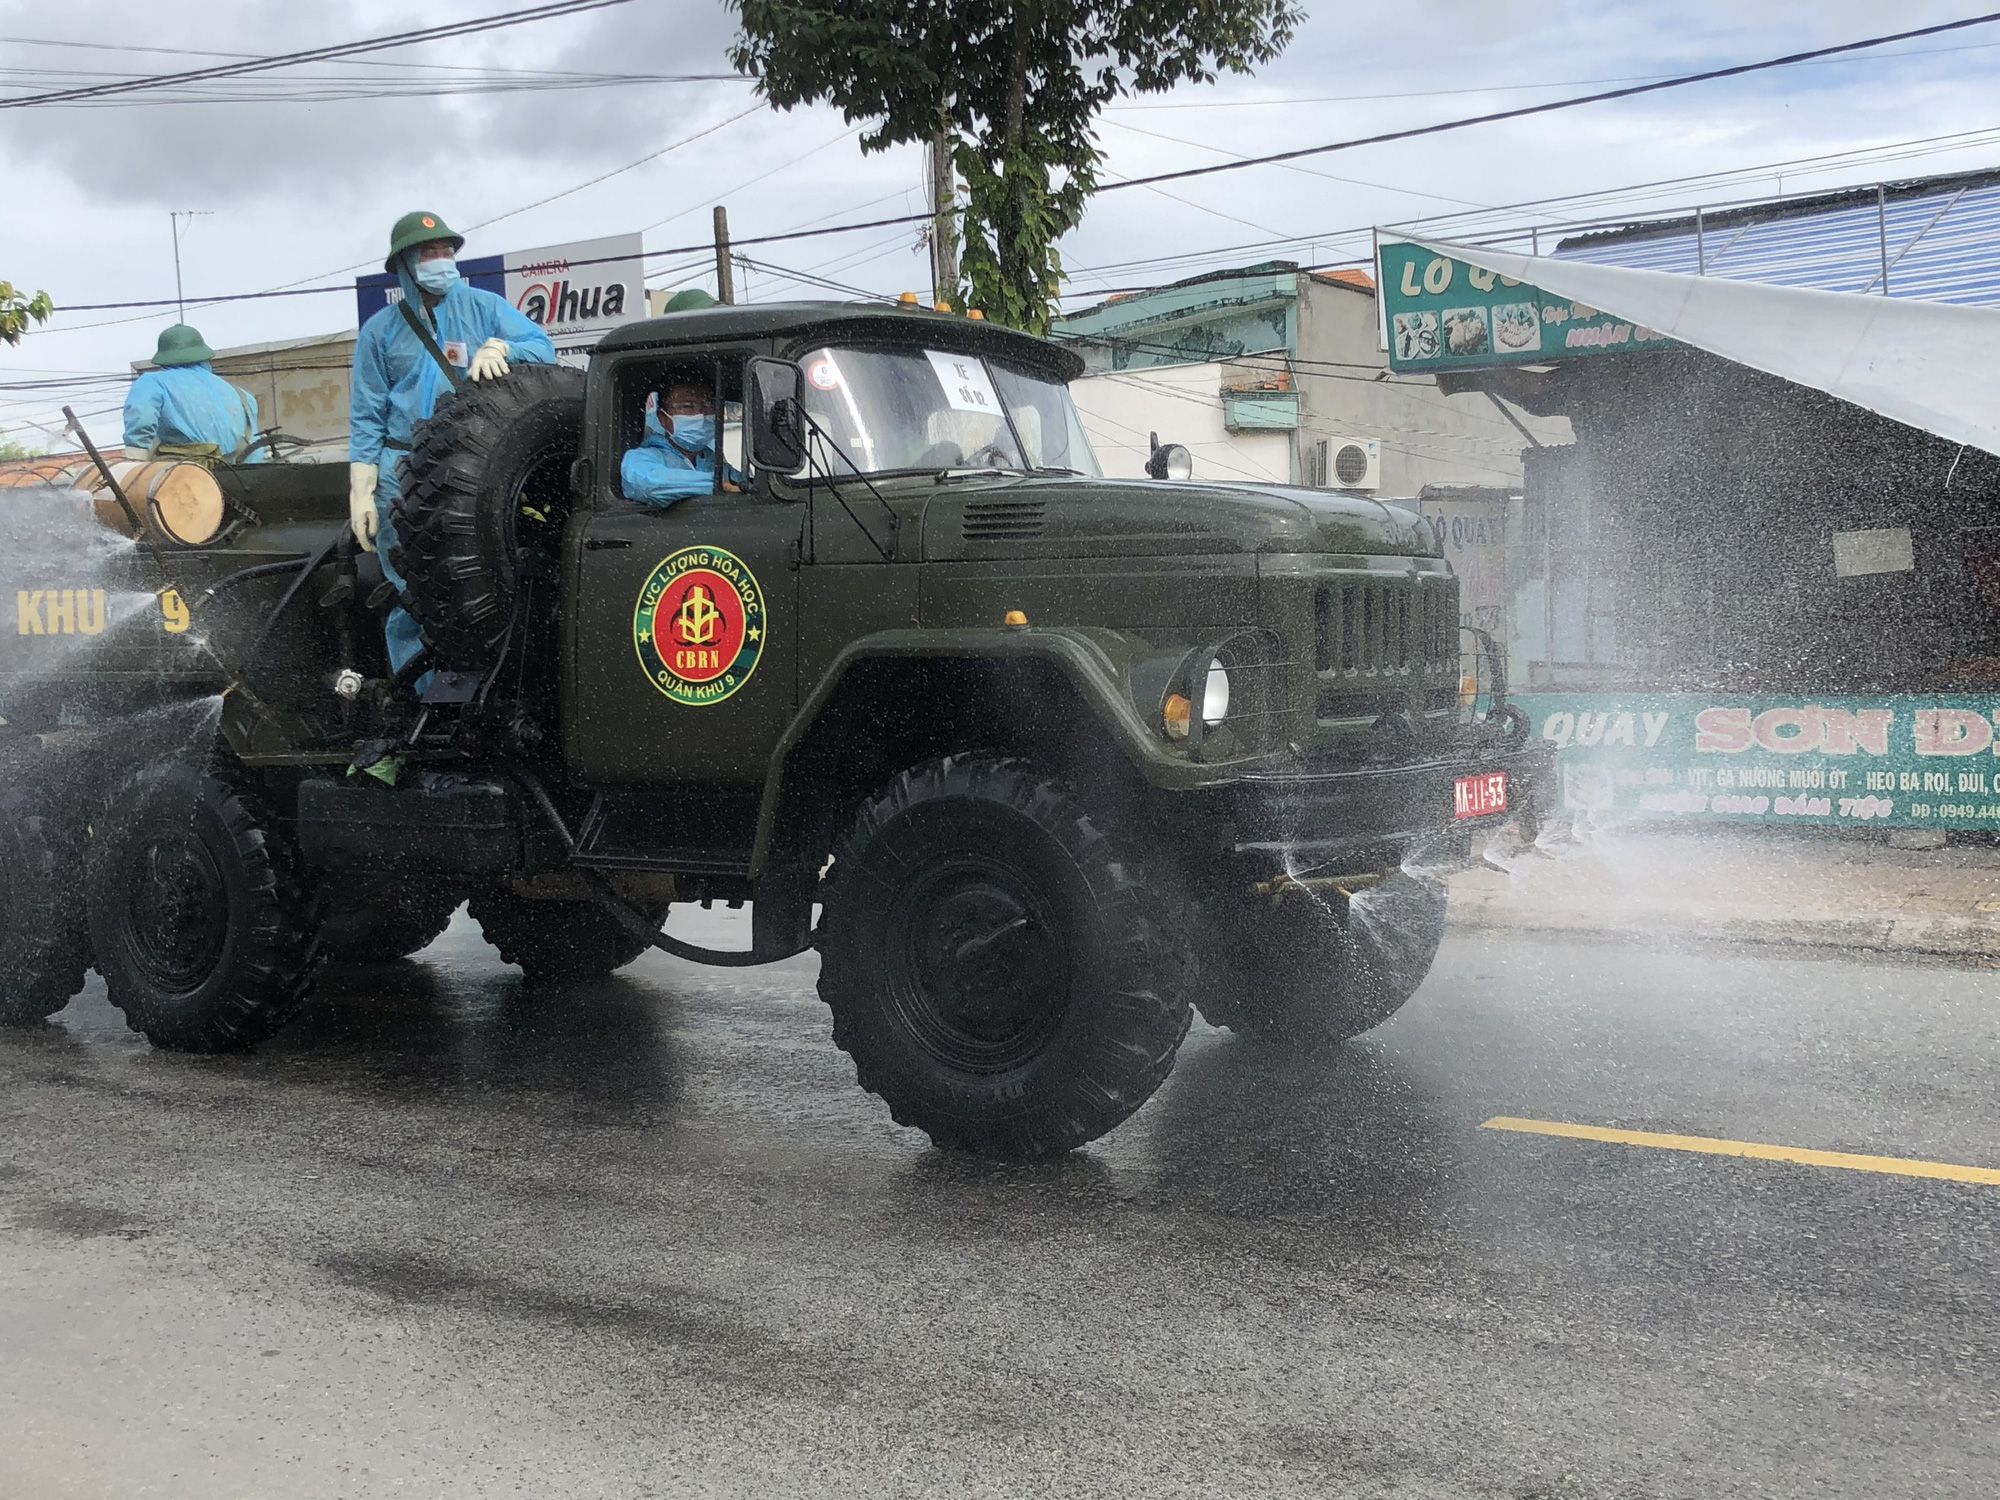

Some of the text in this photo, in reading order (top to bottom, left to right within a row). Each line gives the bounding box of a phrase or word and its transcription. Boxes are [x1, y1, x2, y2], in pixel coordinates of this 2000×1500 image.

[521, 259, 570, 278] CAMERA
[953, 363, 970, 380] XE
[659, 553, 709, 583] LƯỢNG
[712, 555, 740, 582] HÓA
[738, 579, 759, 615] HỌC
[17, 589, 190, 635] KHU 9
[676, 650, 719, 669] CBRN
[657, 670, 736, 698] QUÂN KHU 9
[1543, 711, 1669, 749] QUAY
[1866, 771, 1896, 791] HEO
[1900, 772, 1920, 791] BA
